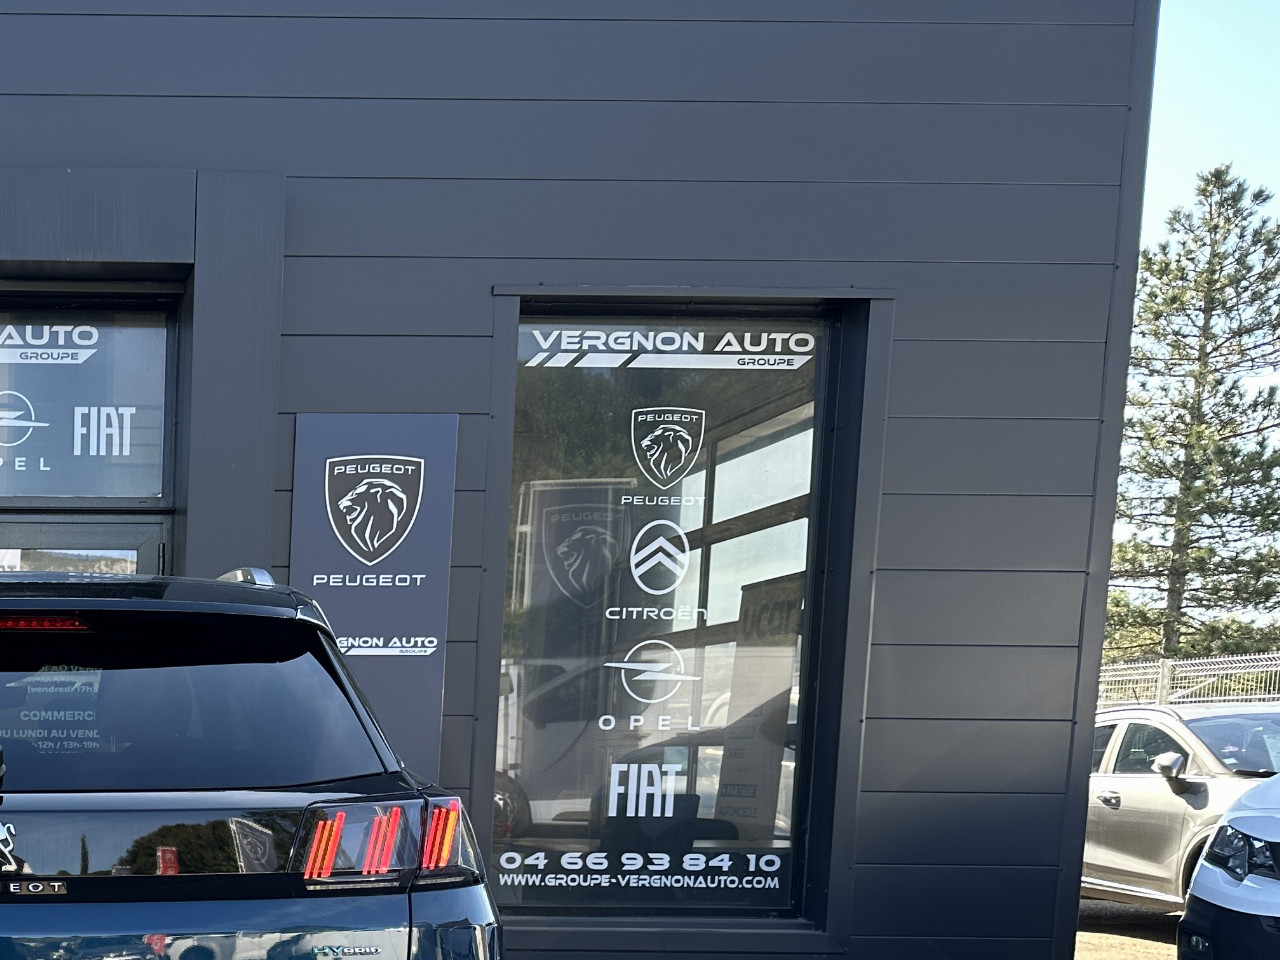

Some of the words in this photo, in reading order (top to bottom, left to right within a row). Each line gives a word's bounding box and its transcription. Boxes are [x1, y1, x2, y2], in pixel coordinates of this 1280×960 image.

[531, 330, 704, 351] VERGNON
[714, 332, 815, 352] AUTO
[19, 351, 79, 361] GROUPE
[737, 357, 795, 367] GROUPE
[637, 413, 699, 423] PEUGEOT
[73, 406, 136, 456] FIAT
[333, 464, 416, 476] PEUGEOT
[621, 495, 706, 506] PEUGEOT
[313, 574, 426, 587] PEUGEOT
[605, 605, 707, 620] CITROËN
[337, 636, 384, 647] GNON
[387, 636, 438, 647] AUTO
[598, 715, 700, 731] OPEL
[13, 729, 48, 738] LUNDI
[50, 729, 67, 738] AU
[608, 763, 682, 818] FIAT
[499, 851, 548, 870] 04
[560, 852, 609, 870] 66
[620, 853, 670, 871] 93
[682, 853, 733, 872] 84
[747, 853, 781, 872] 10
[498, 873, 780, 889] WWW.GROUPE-VERGNONAUTO.COM
